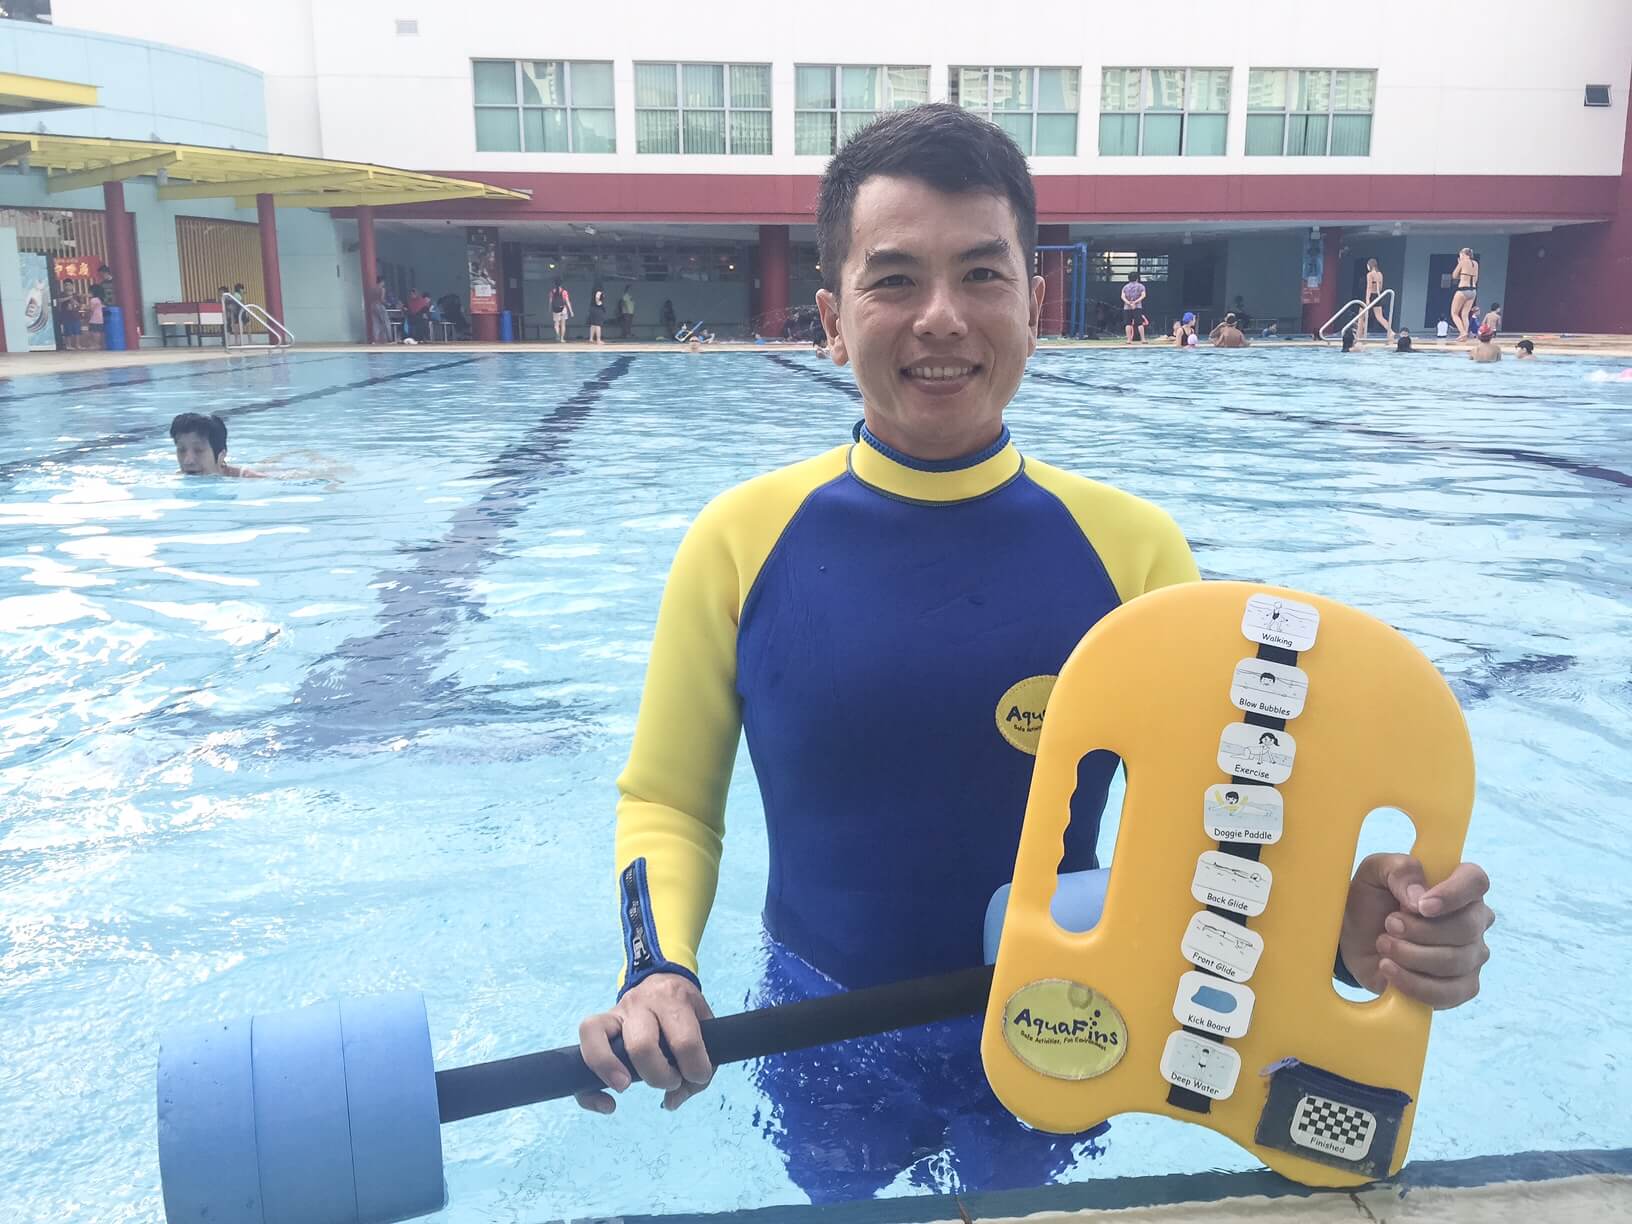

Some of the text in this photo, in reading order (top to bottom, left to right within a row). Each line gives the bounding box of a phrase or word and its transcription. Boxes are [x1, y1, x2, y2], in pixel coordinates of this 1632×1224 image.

[1262, 633, 1293, 647] Walking
[1006, 705, 1046, 726] Aqu
[1239, 698, 1291, 716] Blow Bubbles
[1234, 764, 1270, 779] Exercise
[1214, 828, 1272, 840] Doggie Paddle
[1206, 892, 1248, 911] Back Glide
[1192, 951, 1236, 977] Front Glide
[1013, 1008, 1119, 1046] AquaFins
[1187, 1014, 1231, 1033] Kick Board
[1170, 1071, 1220, 1095] Deep Water
[1310, 1136, 1346, 1154] Finished
